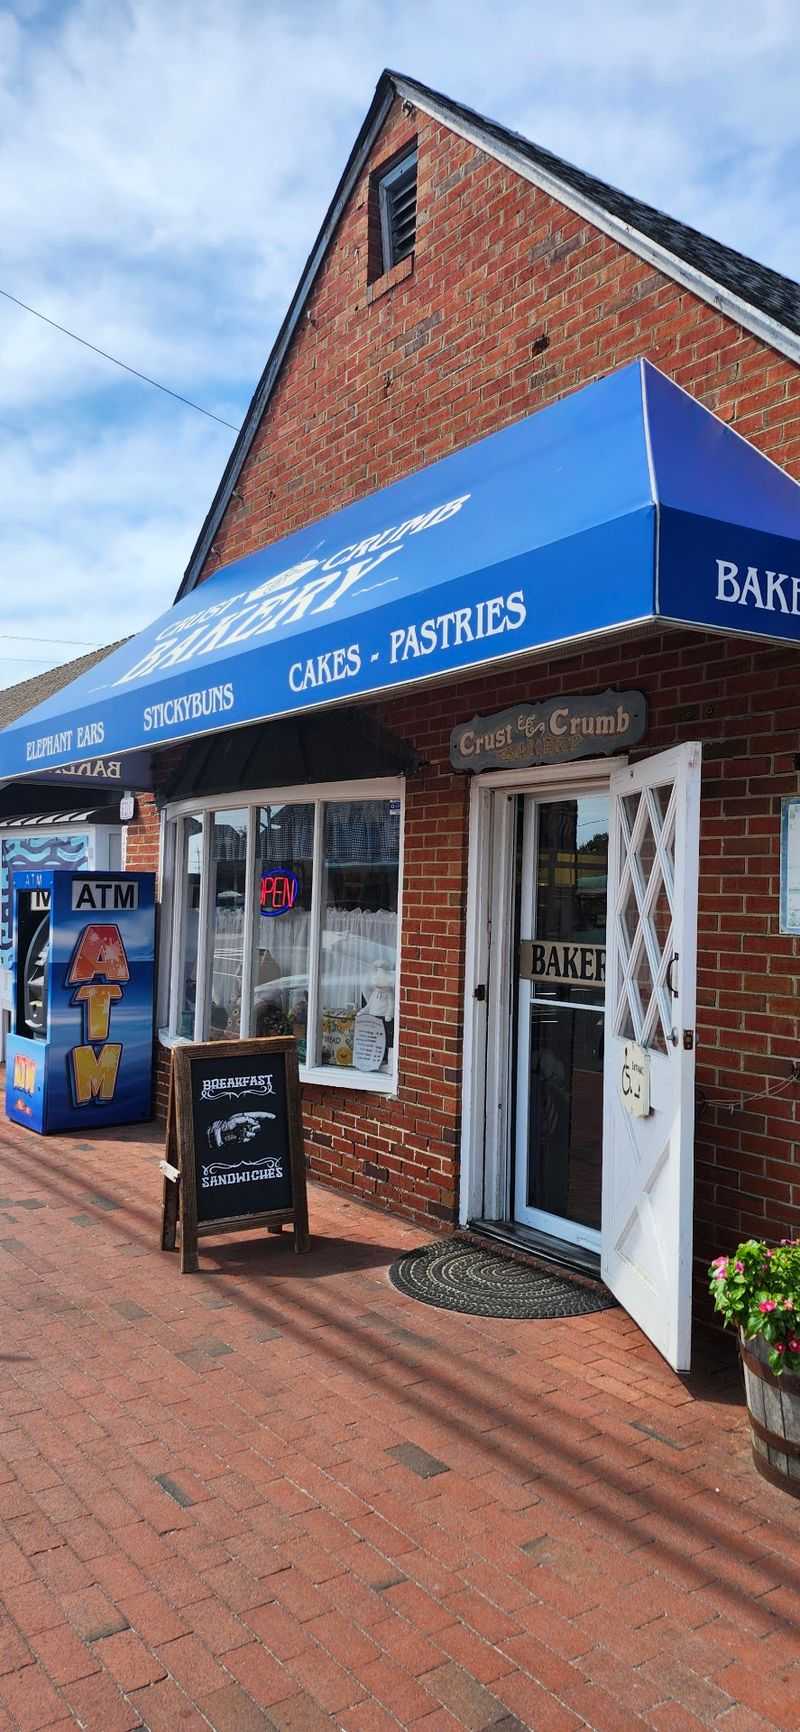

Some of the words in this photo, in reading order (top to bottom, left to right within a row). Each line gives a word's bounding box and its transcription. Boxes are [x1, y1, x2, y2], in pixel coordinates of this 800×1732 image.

[154, 591, 248, 641] CRUST
[321, 494, 471, 571] CRUMB
[111, 544, 403, 688] BAKERY
[288, 643, 361, 692] CAKES
[389, 590, 527, 664] PASTRIES
[143, 682, 234, 732] STICKYBUNS
[459, 724, 513, 758] Crust
[550, 705, 630, 736] Crumb
[26, 729, 73, 761] ELEPHANT
[76, 721, 105, 748] EARS
[75, 883, 135, 909] ATM
[260, 876, 295, 907] PEN
[67, 924, 130, 1107] ATM
[202, 1074, 273, 1090] BREAKFAST
[201, 1167, 283, 1188] SANDWICHES
